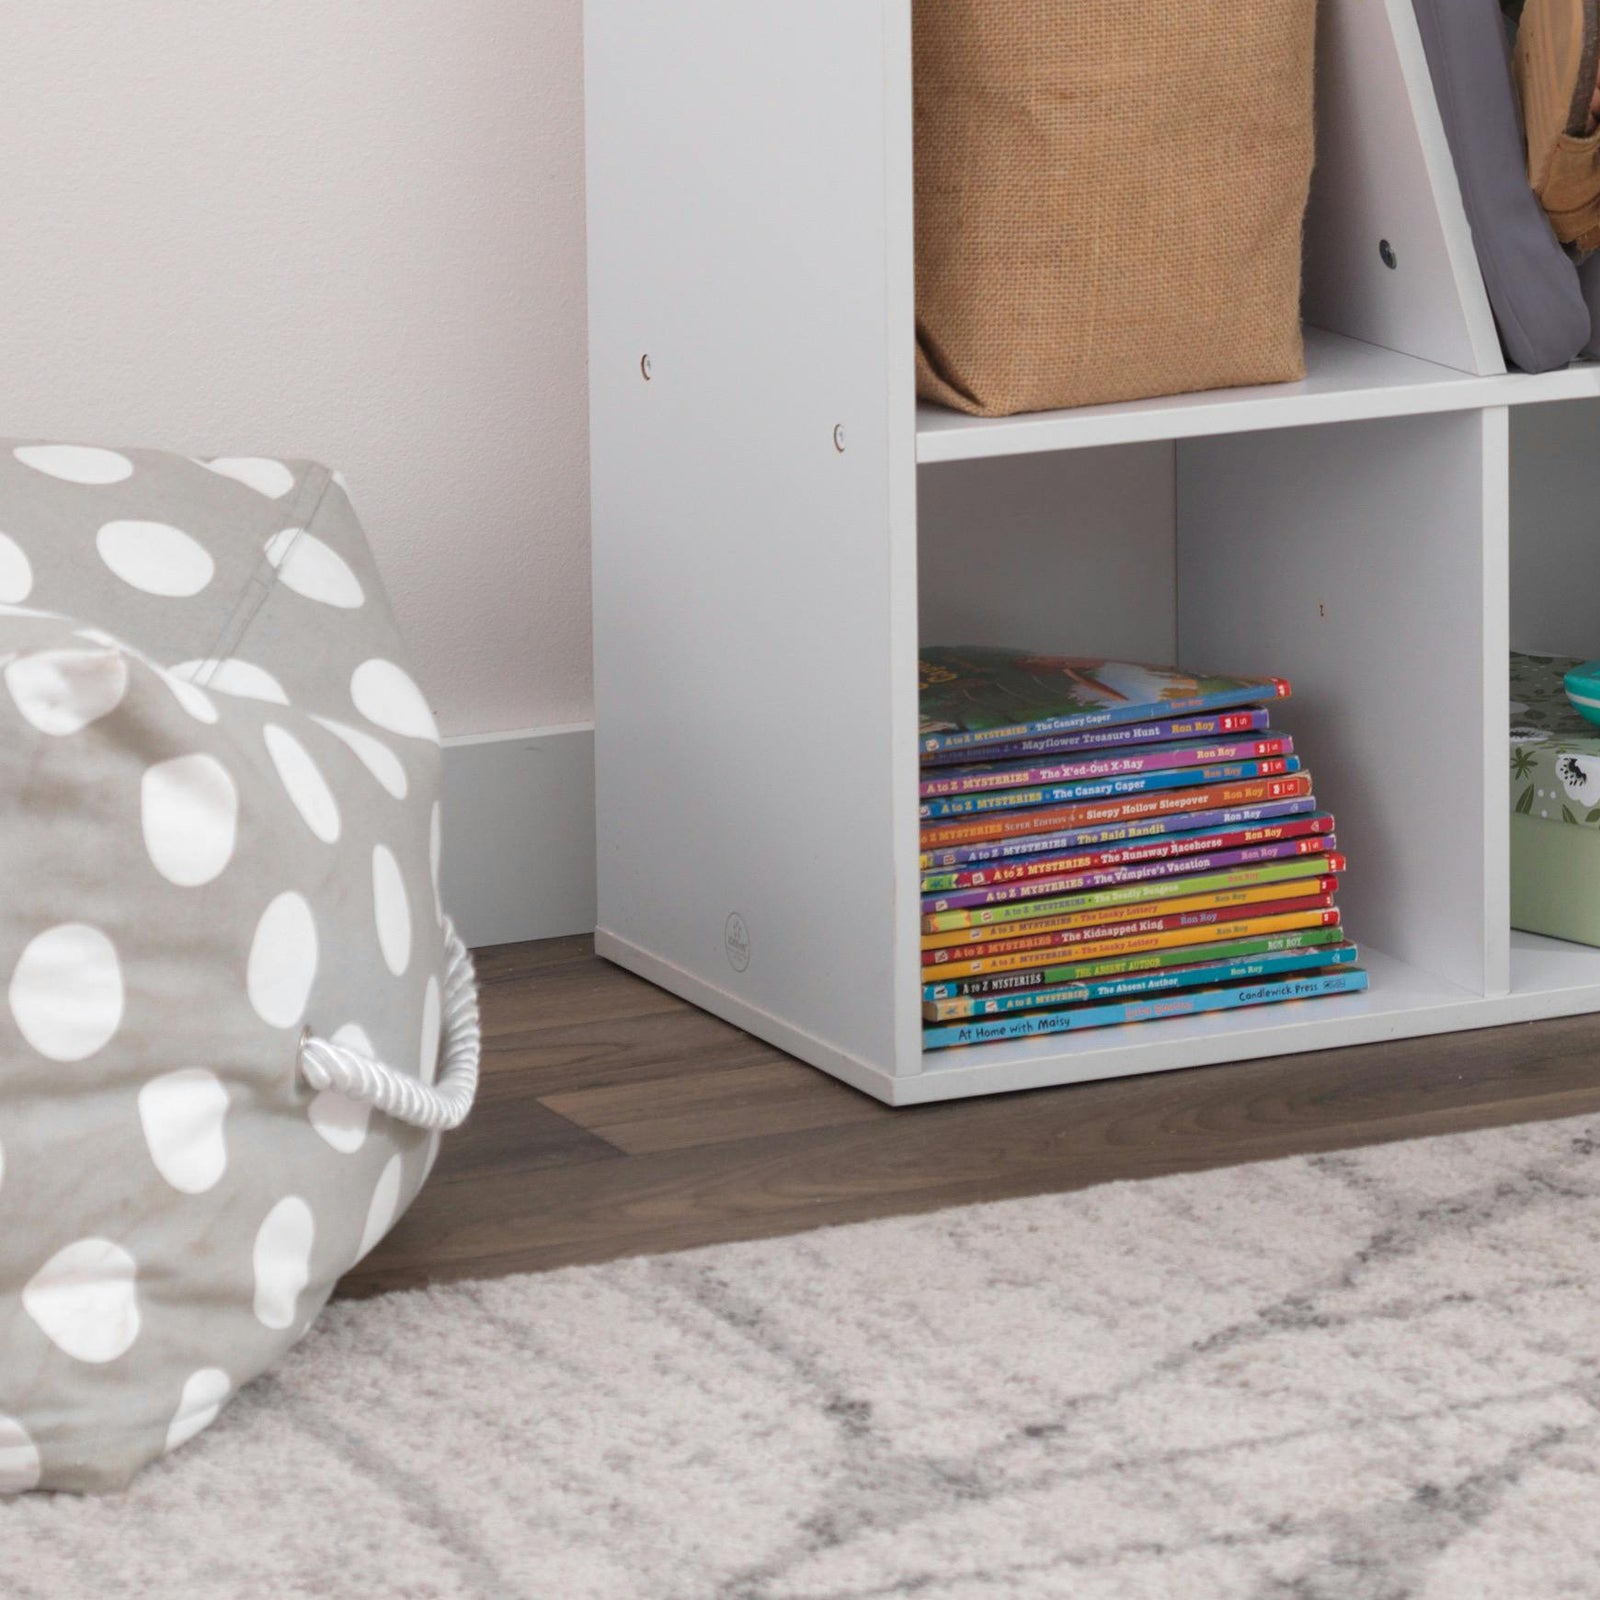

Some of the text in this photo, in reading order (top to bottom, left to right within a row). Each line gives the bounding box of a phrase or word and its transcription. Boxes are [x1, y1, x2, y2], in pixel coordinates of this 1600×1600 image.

[974, 712, 1111, 741] MYSTERIES The Canary Caper
[1022, 736, 1080, 751] Mayflower
[1082, 730, 1131, 744] Treasure
[1132, 726, 1161, 738] Hunt
[1171, 723, 1192, 734] Ron
[1194, 721, 1215, 733] Roy
[926, 783, 936, 794] A
[963, 772, 1030, 790] MYSTERIES
[1040, 768, 1060, 780] The
[1110, 758, 1145, 772] X-Ray
[1197, 750, 1216, 759] Ron
[939, 824, 1002, 841] MYSTERIES
[1087, 805, 1119, 820] Sleepy
[1122, 802, 1157, 816] Hollow
[1159, 794, 1209, 812] Sleepover
[1223, 789, 1246, 801] Ron
[941, 779, 1146, 814] A MYSTERIES The Canary Caper
[969, 809, 1262, 861] A to MYSTERIES The Bald Bandit Ron Roy
[993, 827, 1283, 881] A to MYSTERIES The Runaway Racehorse Ron Roy
[986, 847, 1278, 902] A to MYSTERIES The Vampire's Vacation Ron Roy
[1019, 915, 1072, 931] MYSTERIES
[1127, 904, 1159, 917] Lottery
[1033, 897, 1085, 913] MYSTERIES
[1113, 888, 1143, 902] Deadly
[988, 912, 1218, 953] MYSTERIES The Kidnapped King Ron Roy
[1019, 949, 1073, 965] MYSTERIES
[1126, 937, 1160, 951] Lottery
[963, 957, 1161, 995] A MYSTERIES THE ABSENT AUTHOR
[1035, 976, 1178, 1005] MYSTERIES The Absent Author
[958, 1027, 972, 1041] At
[976, 1025, 1007, 1038] Home
[1009, 1019, 1034, 1035] with
[1037, 1015, 1071, 1031] Maisy
[1238, 985, 1293, 1002] Candlewick
